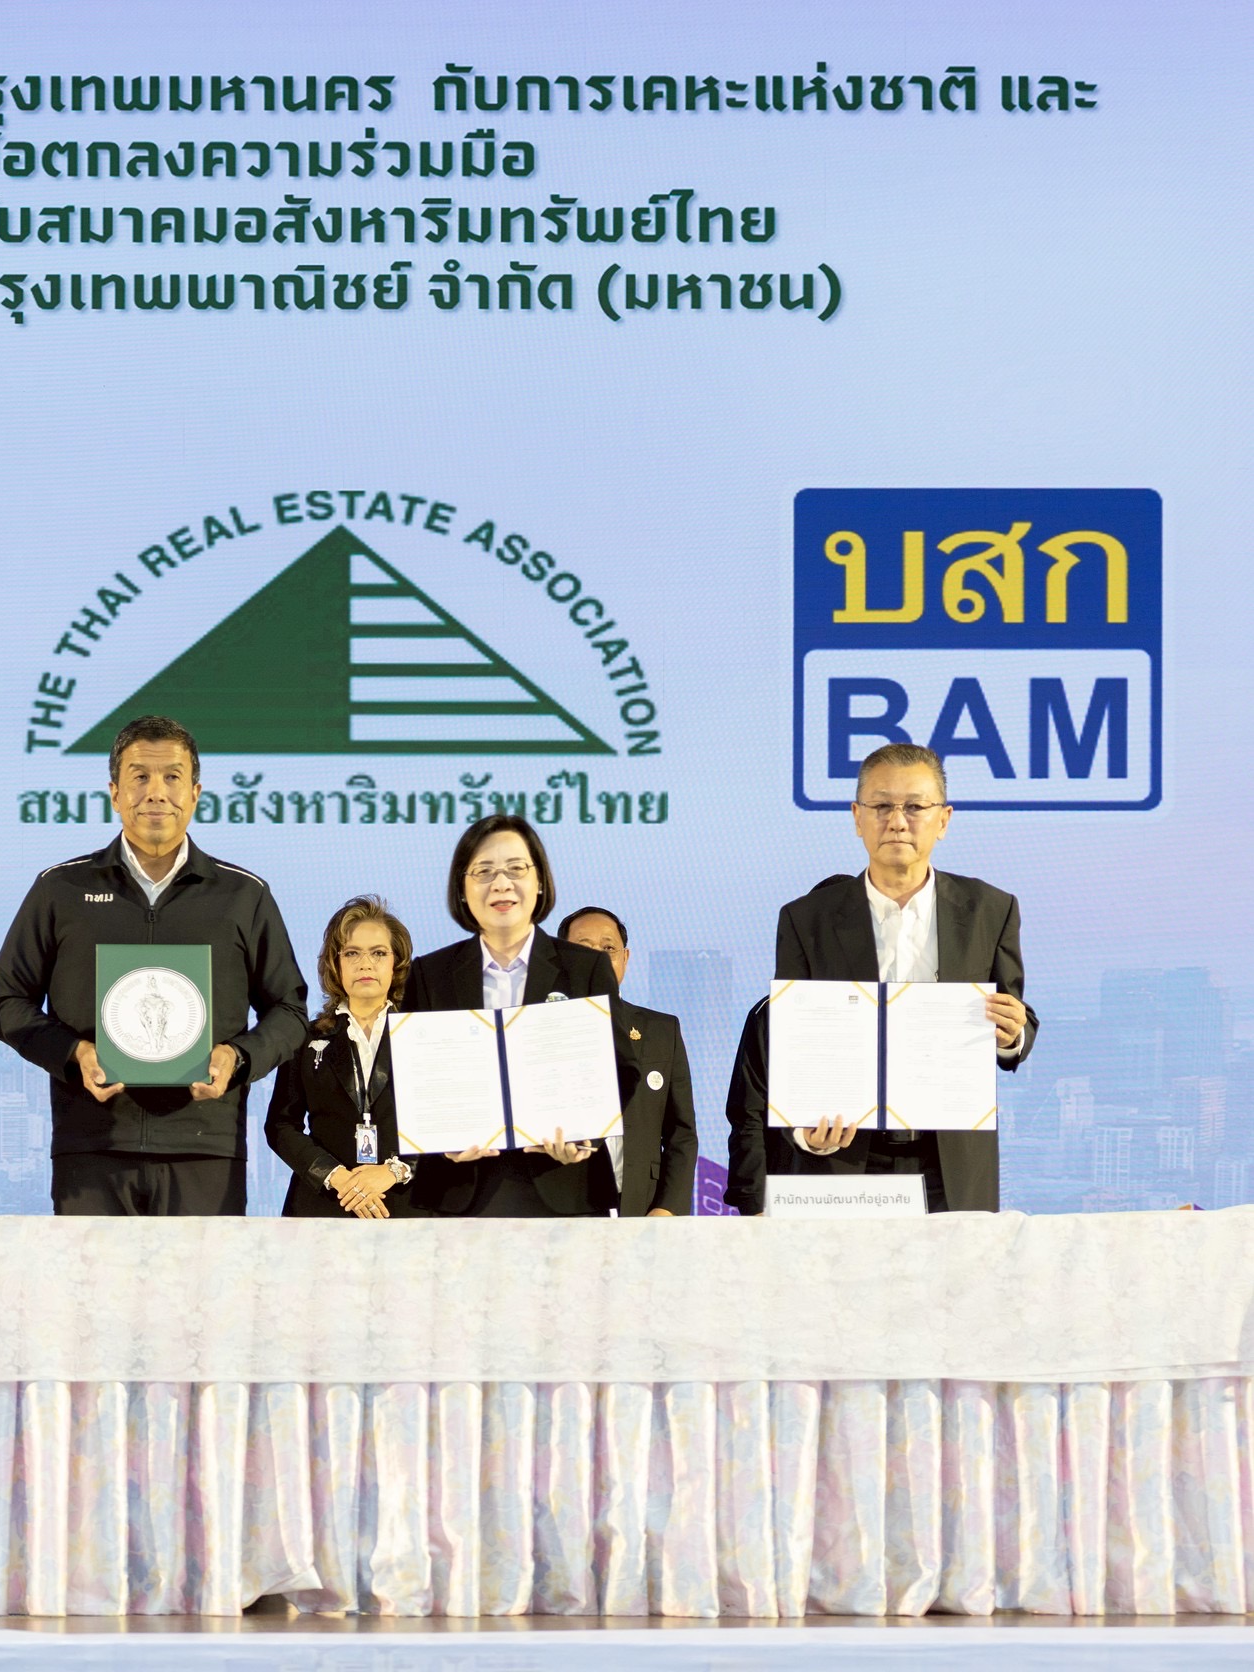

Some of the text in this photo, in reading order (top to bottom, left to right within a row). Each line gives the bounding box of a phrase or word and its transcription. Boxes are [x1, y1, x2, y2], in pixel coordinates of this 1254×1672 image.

[433, 62, 976, 112] กับการเคหะแห่งชาติ
[1002, 74, 1098, 112] และ
[429, 261, 573, 310] จำกัด
[598, 263, 842, 322] (มหาชน)
[824, 521, 1128, 624] บสก
[25, 490, 663, 756] THE THAI REAL ESTATE ASSOCIATION
[827, 677, 1128, 779] BAM
[18, 771, 670, 826] สมาอสังหาริมทรัพย์ไทย
